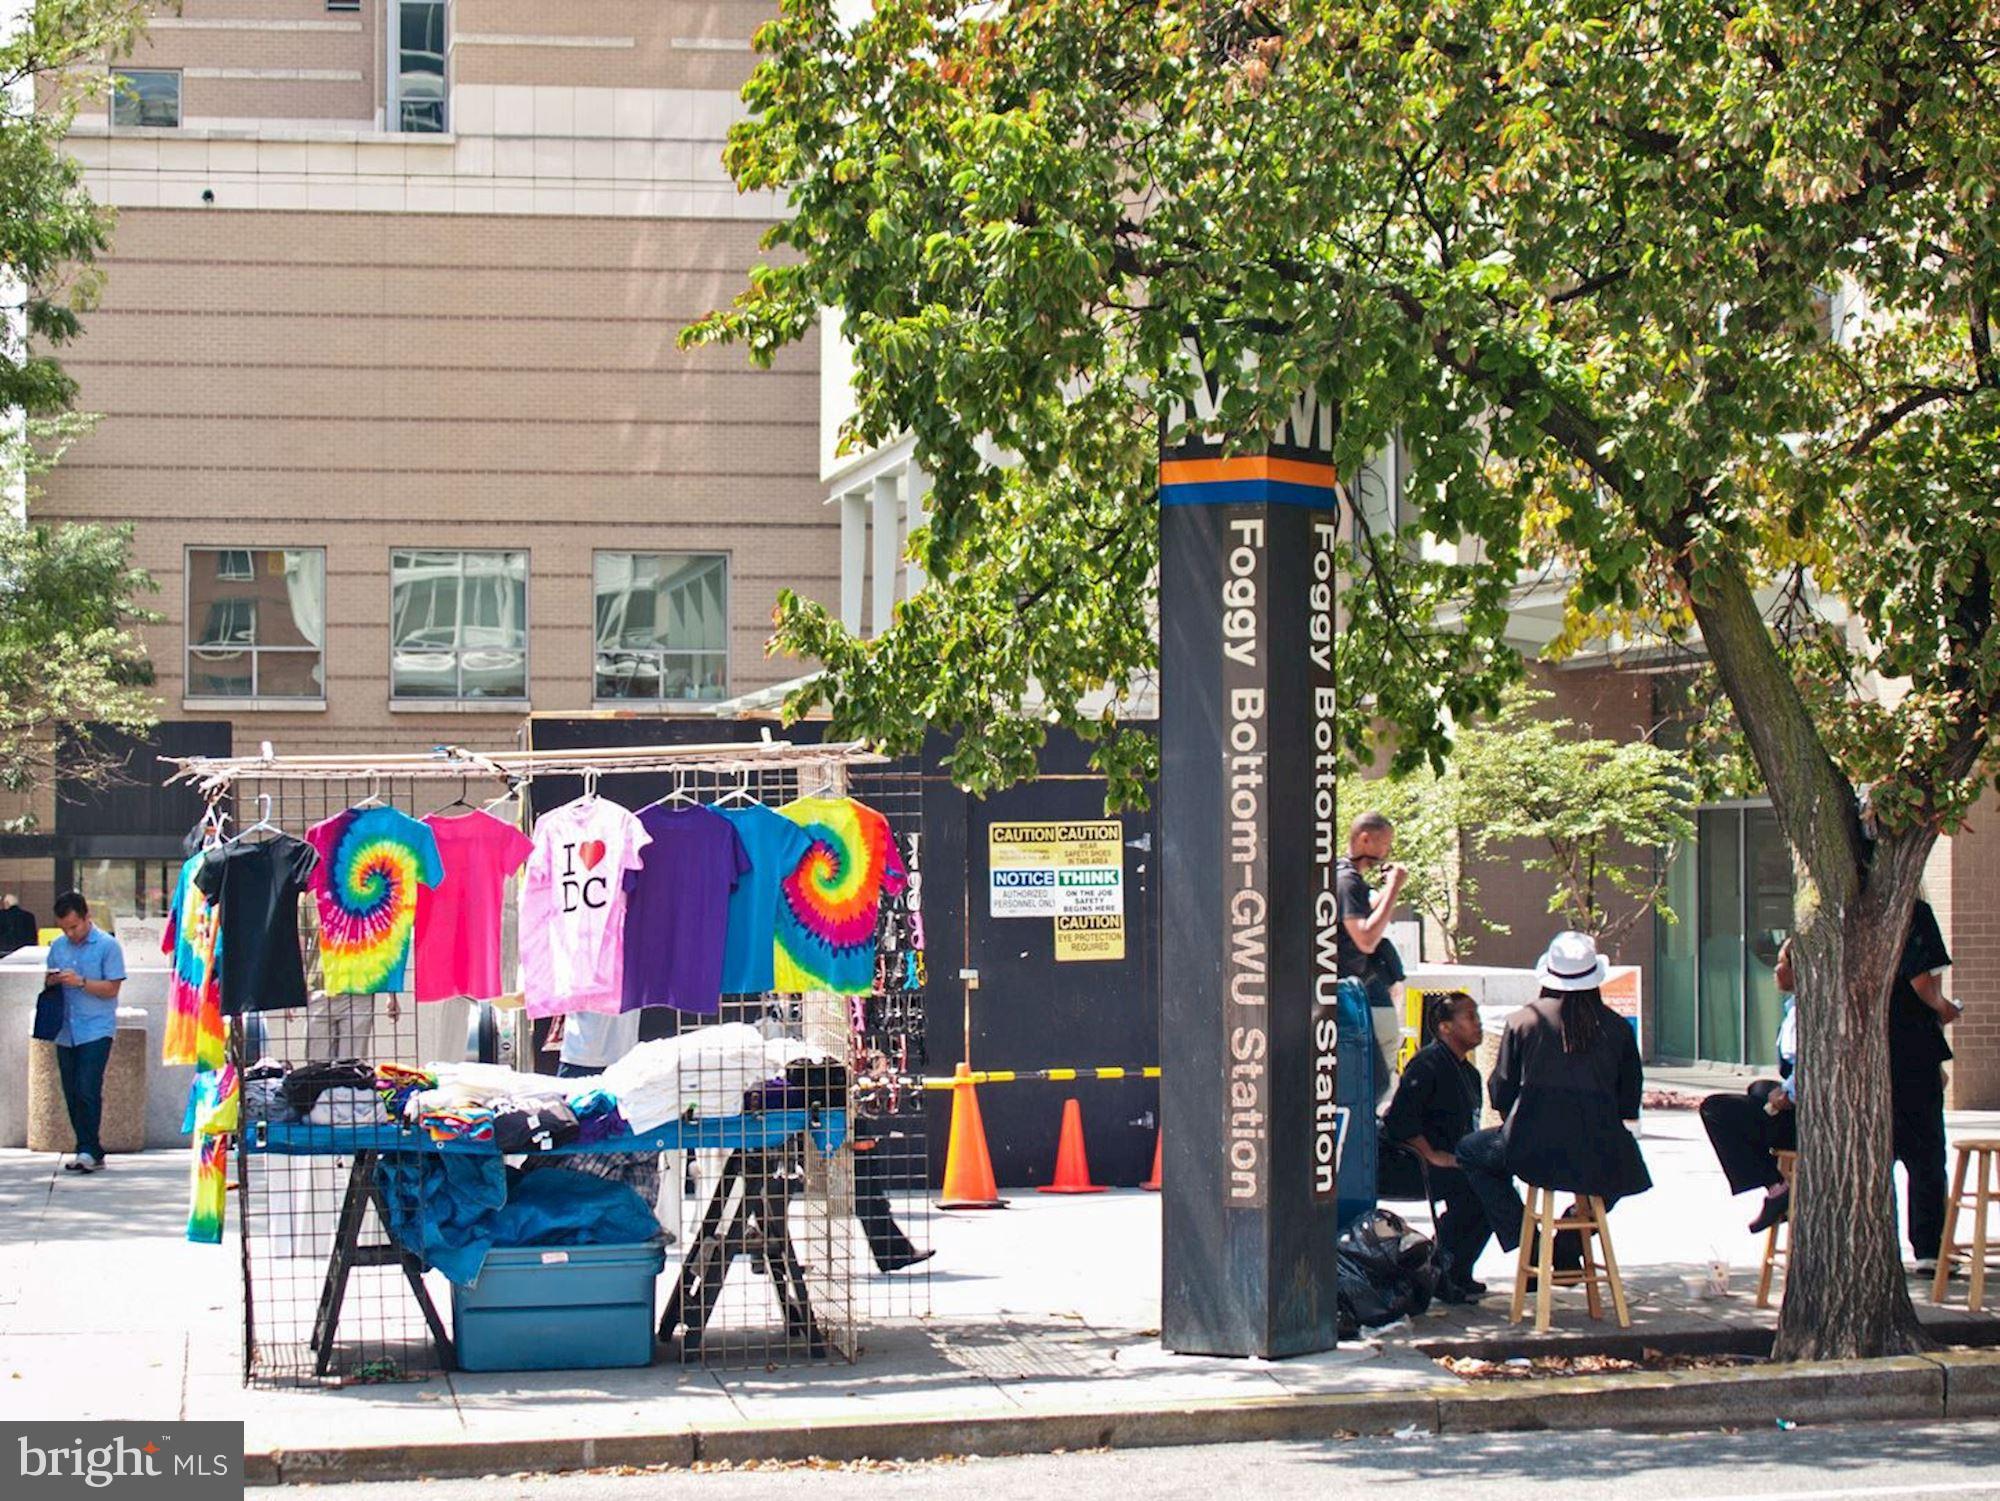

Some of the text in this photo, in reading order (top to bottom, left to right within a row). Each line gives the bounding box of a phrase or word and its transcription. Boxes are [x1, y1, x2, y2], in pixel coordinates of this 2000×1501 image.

[994, 827, 1055, 842] CAUTION
[1058, 825, 1118, 840] CAUTION
[563, 843, 575, 877] I
[1223, 519, 1266, 1198] Foggy Bottom-GWU Station
[1310, 523, 1338, 1193] Foggy Bottom-GWU Station
[996, 871, 1054, 885] NOTICE
[1060, 870, 1117, 885] THINK
[562, 877, 607, 912] DC
[1002, 889, 1048, 898] AUTHORIZED
[994, 899, 1036, 908] PERSONNEL
[1059, 916, 1119, 929] CAUTION
[1058, 932, 1122, 942] EYE PROTECTION
[1071, 942, 1110, 951] REQUIRED
